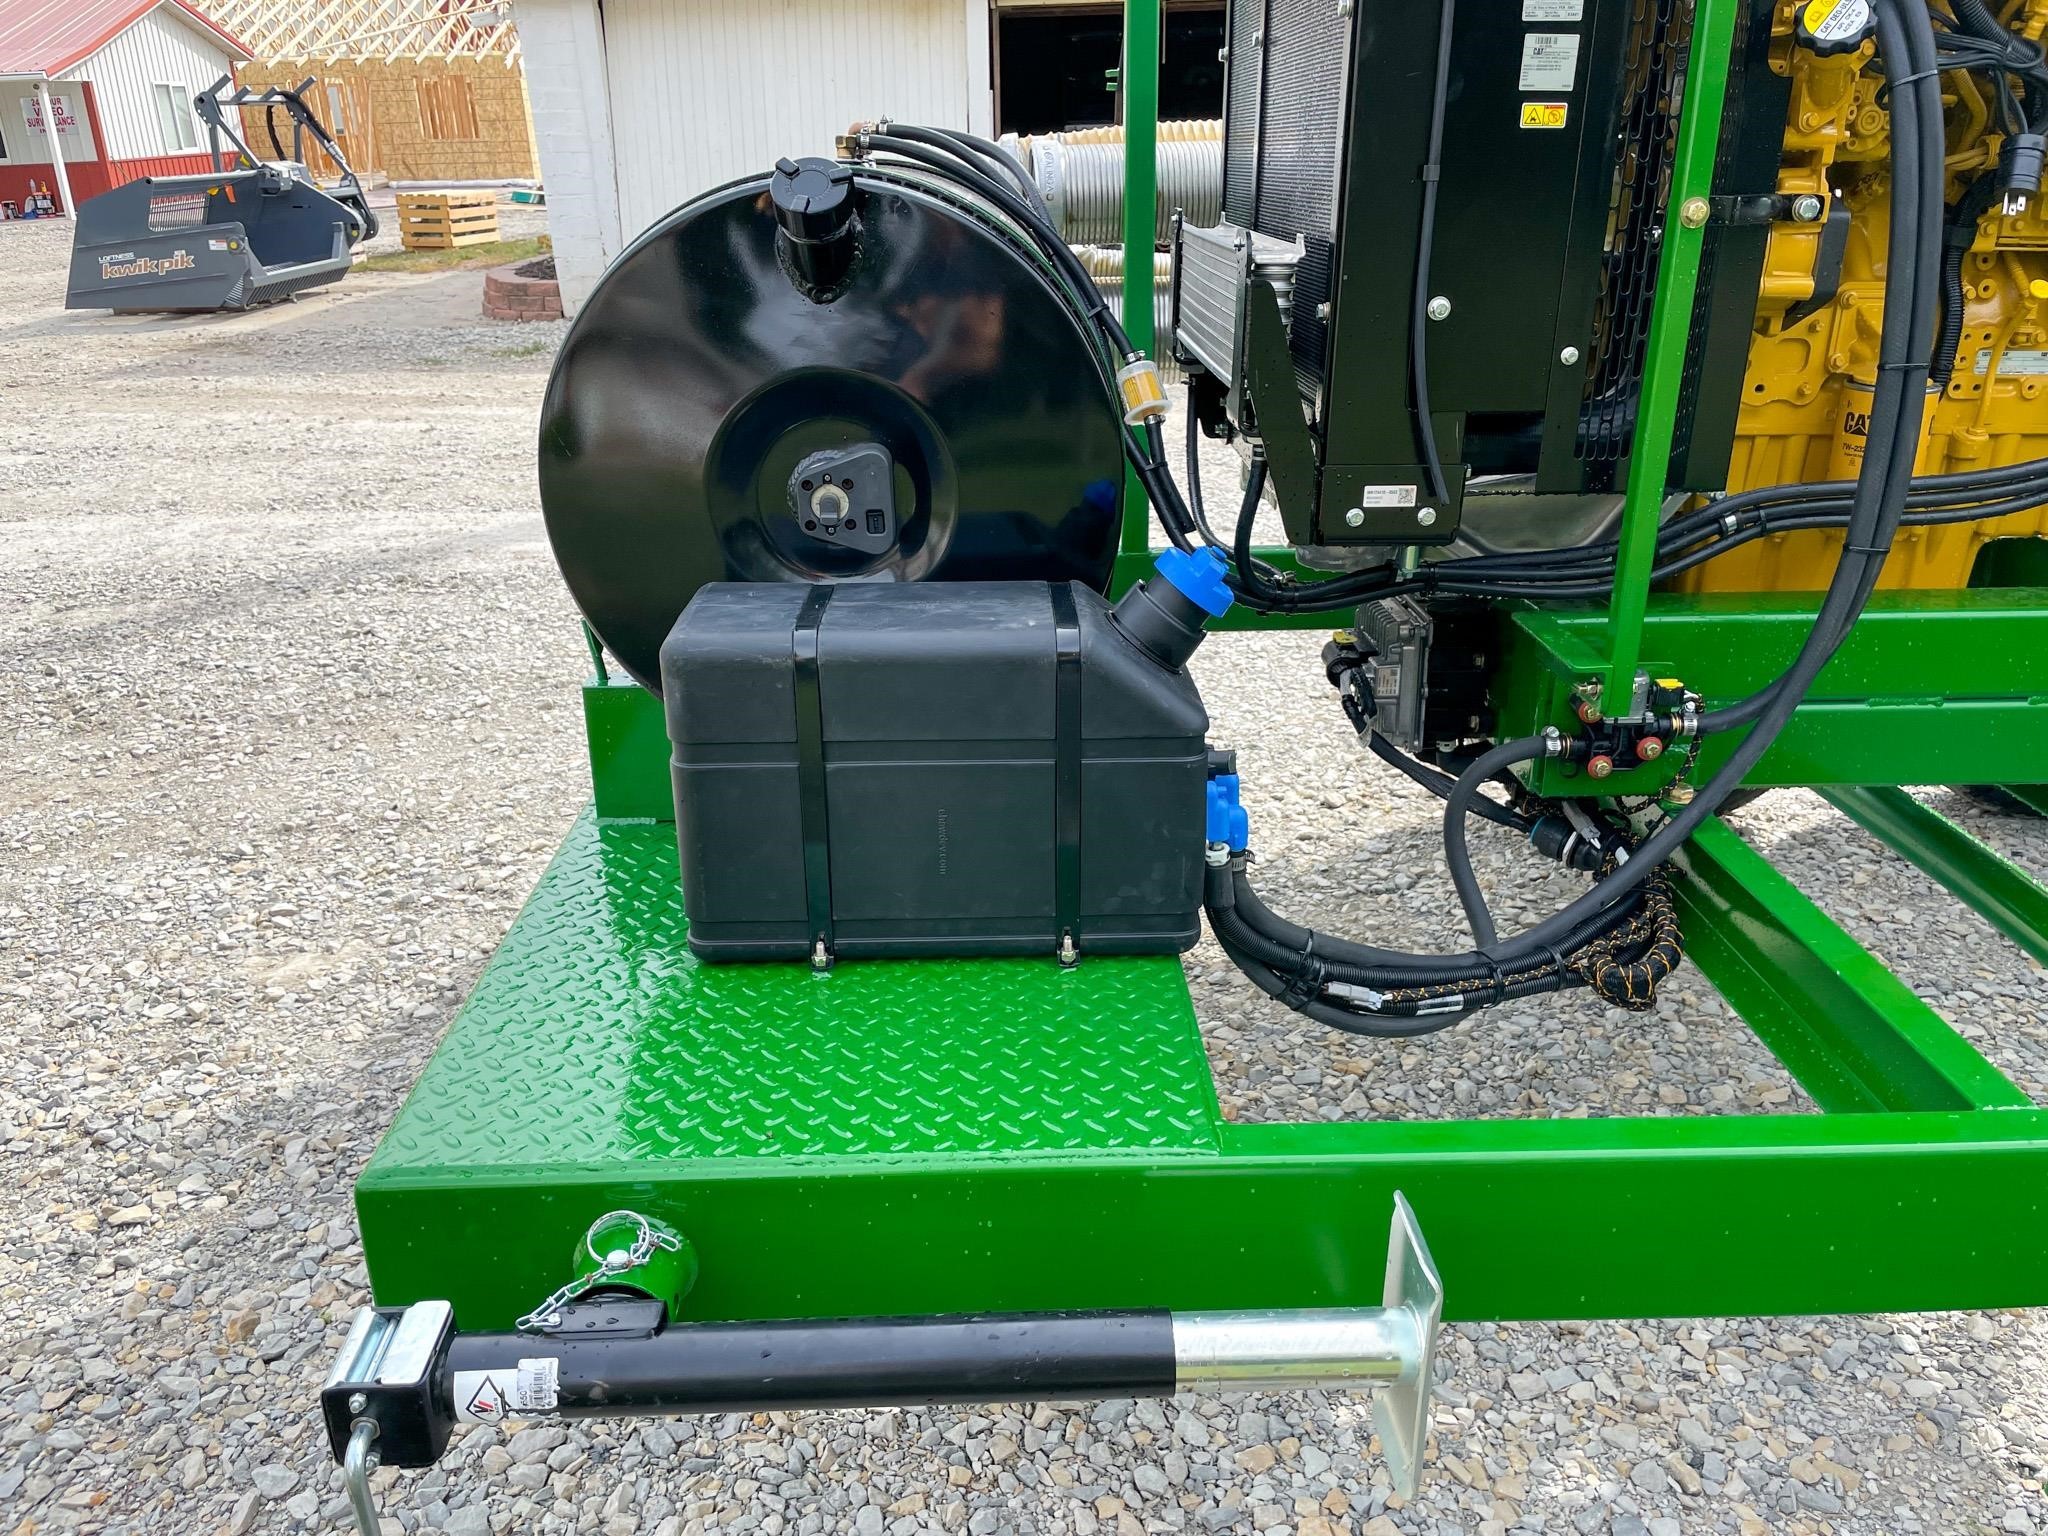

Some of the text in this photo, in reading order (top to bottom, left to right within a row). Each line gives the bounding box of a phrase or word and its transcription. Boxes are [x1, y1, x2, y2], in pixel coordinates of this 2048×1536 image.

[1820, 22, 1832, 33] CAT
[33, 107, 63, 117] VEO
[27, 116, 75, 127] SURVLANCE
[99, 252, 135, 263] LOFTNESS
[103, 254, 195, 279] kwik pik
